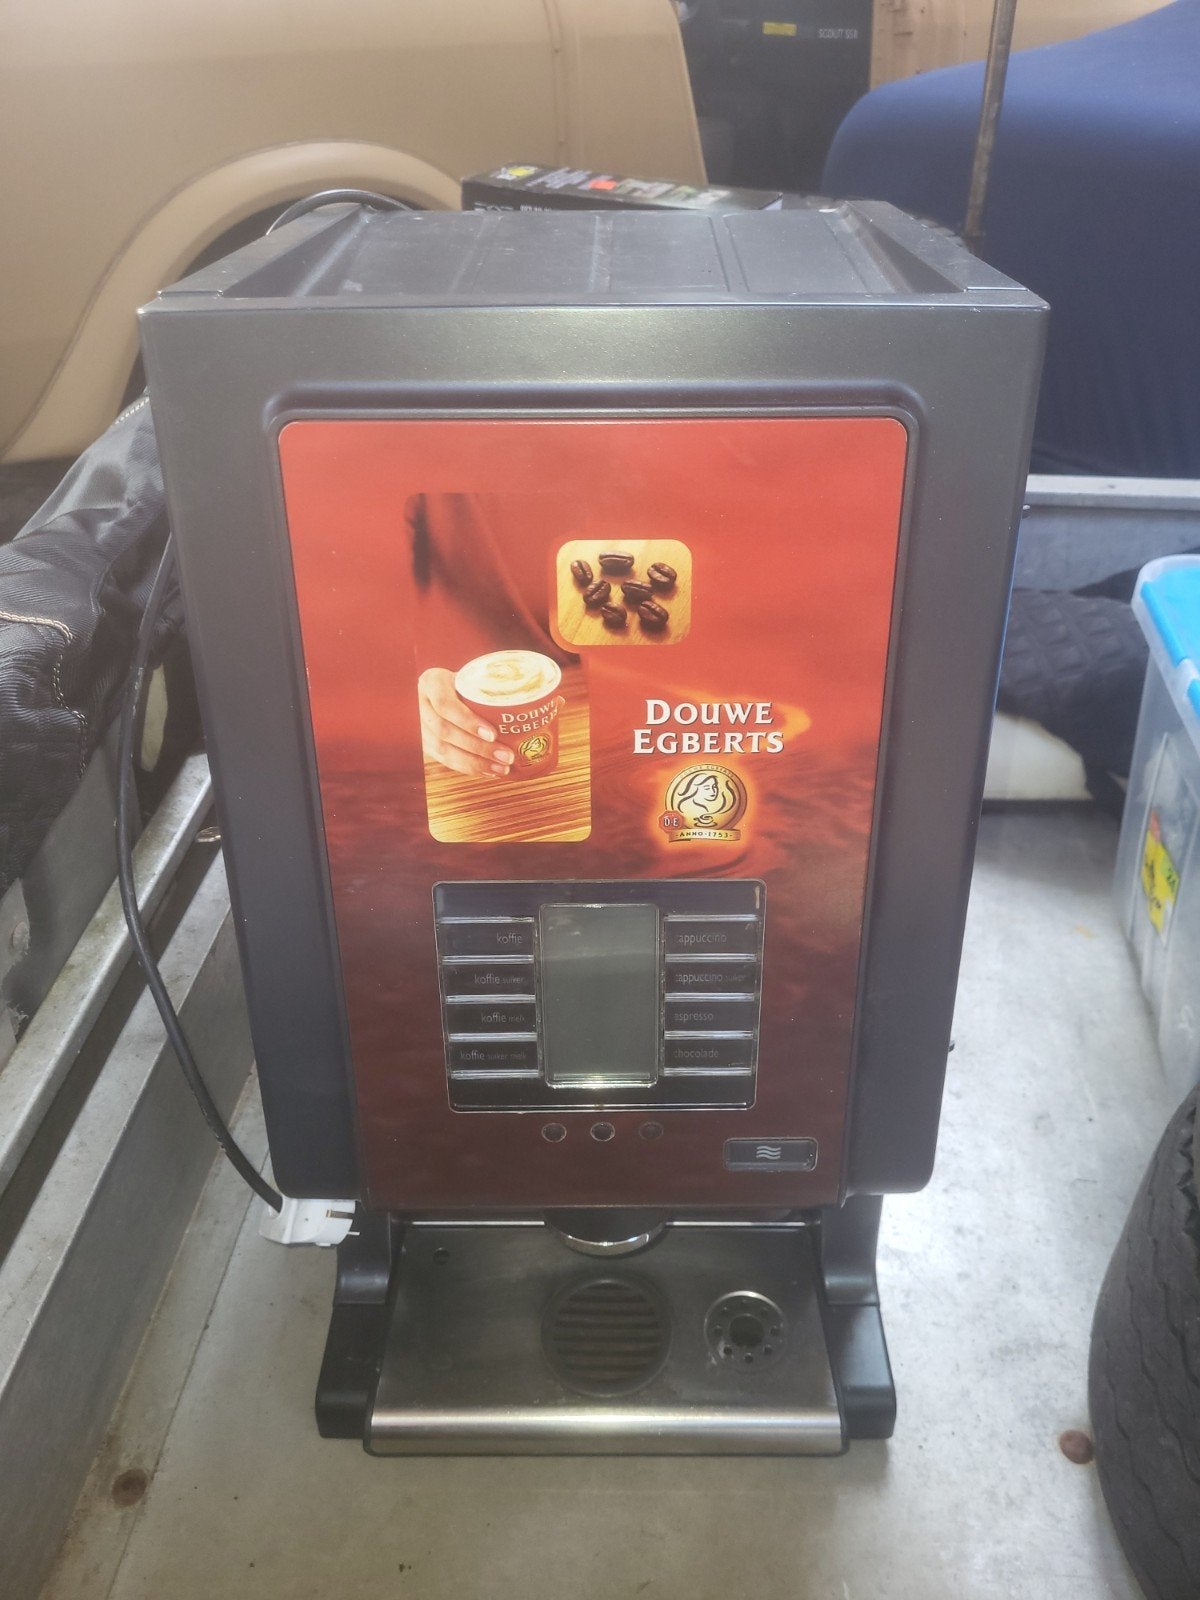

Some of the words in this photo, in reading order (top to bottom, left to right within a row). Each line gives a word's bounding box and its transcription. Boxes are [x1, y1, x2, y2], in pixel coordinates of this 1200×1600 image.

[645, 699, 773, 725] DOUWE
[633, 728, 784, 754] EGBERTS
[496, 932, 523, 944] koffie
[676, 934, 727, 946] appuccino
[474, 973, 500, 985] koffie
[481, 1011, 507, 1023] koffie
[459, 1049, 485, 1061] koffie
